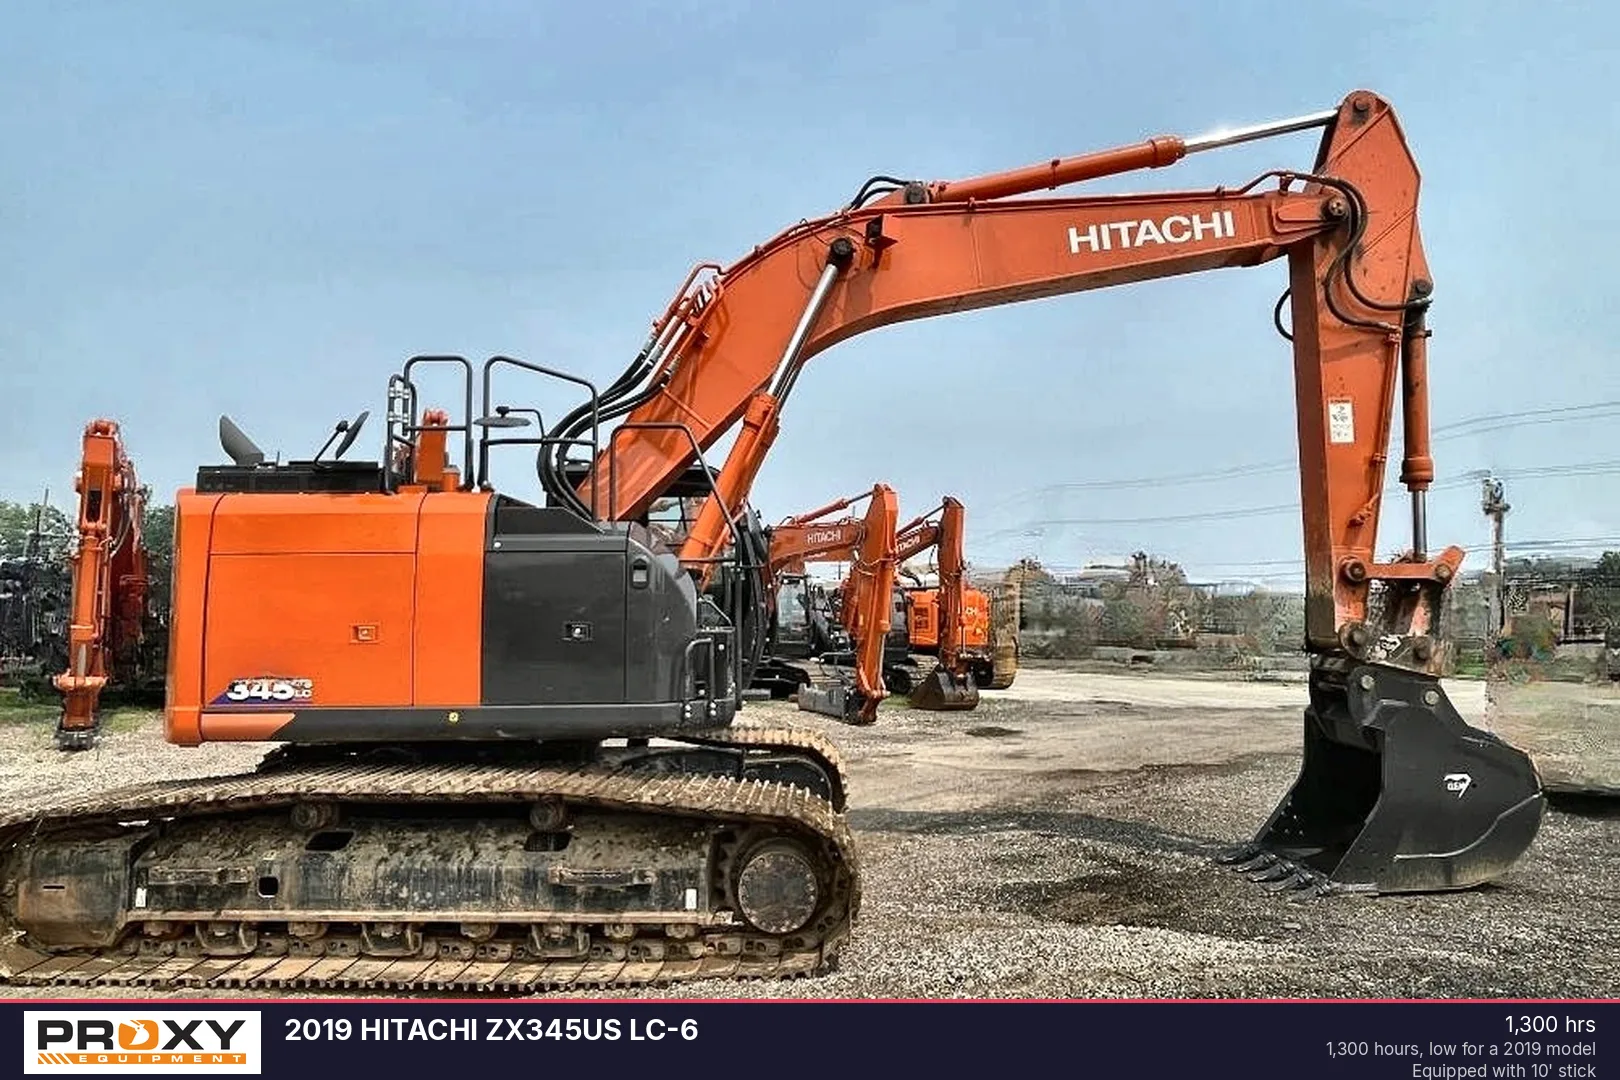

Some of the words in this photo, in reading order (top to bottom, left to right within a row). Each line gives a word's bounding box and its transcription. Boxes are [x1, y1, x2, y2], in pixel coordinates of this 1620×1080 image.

[1068, 210, 1236, 254] HITACHI
[807, 529, 841, 544] HITACHI
[227, 681, 294, 701] 345
